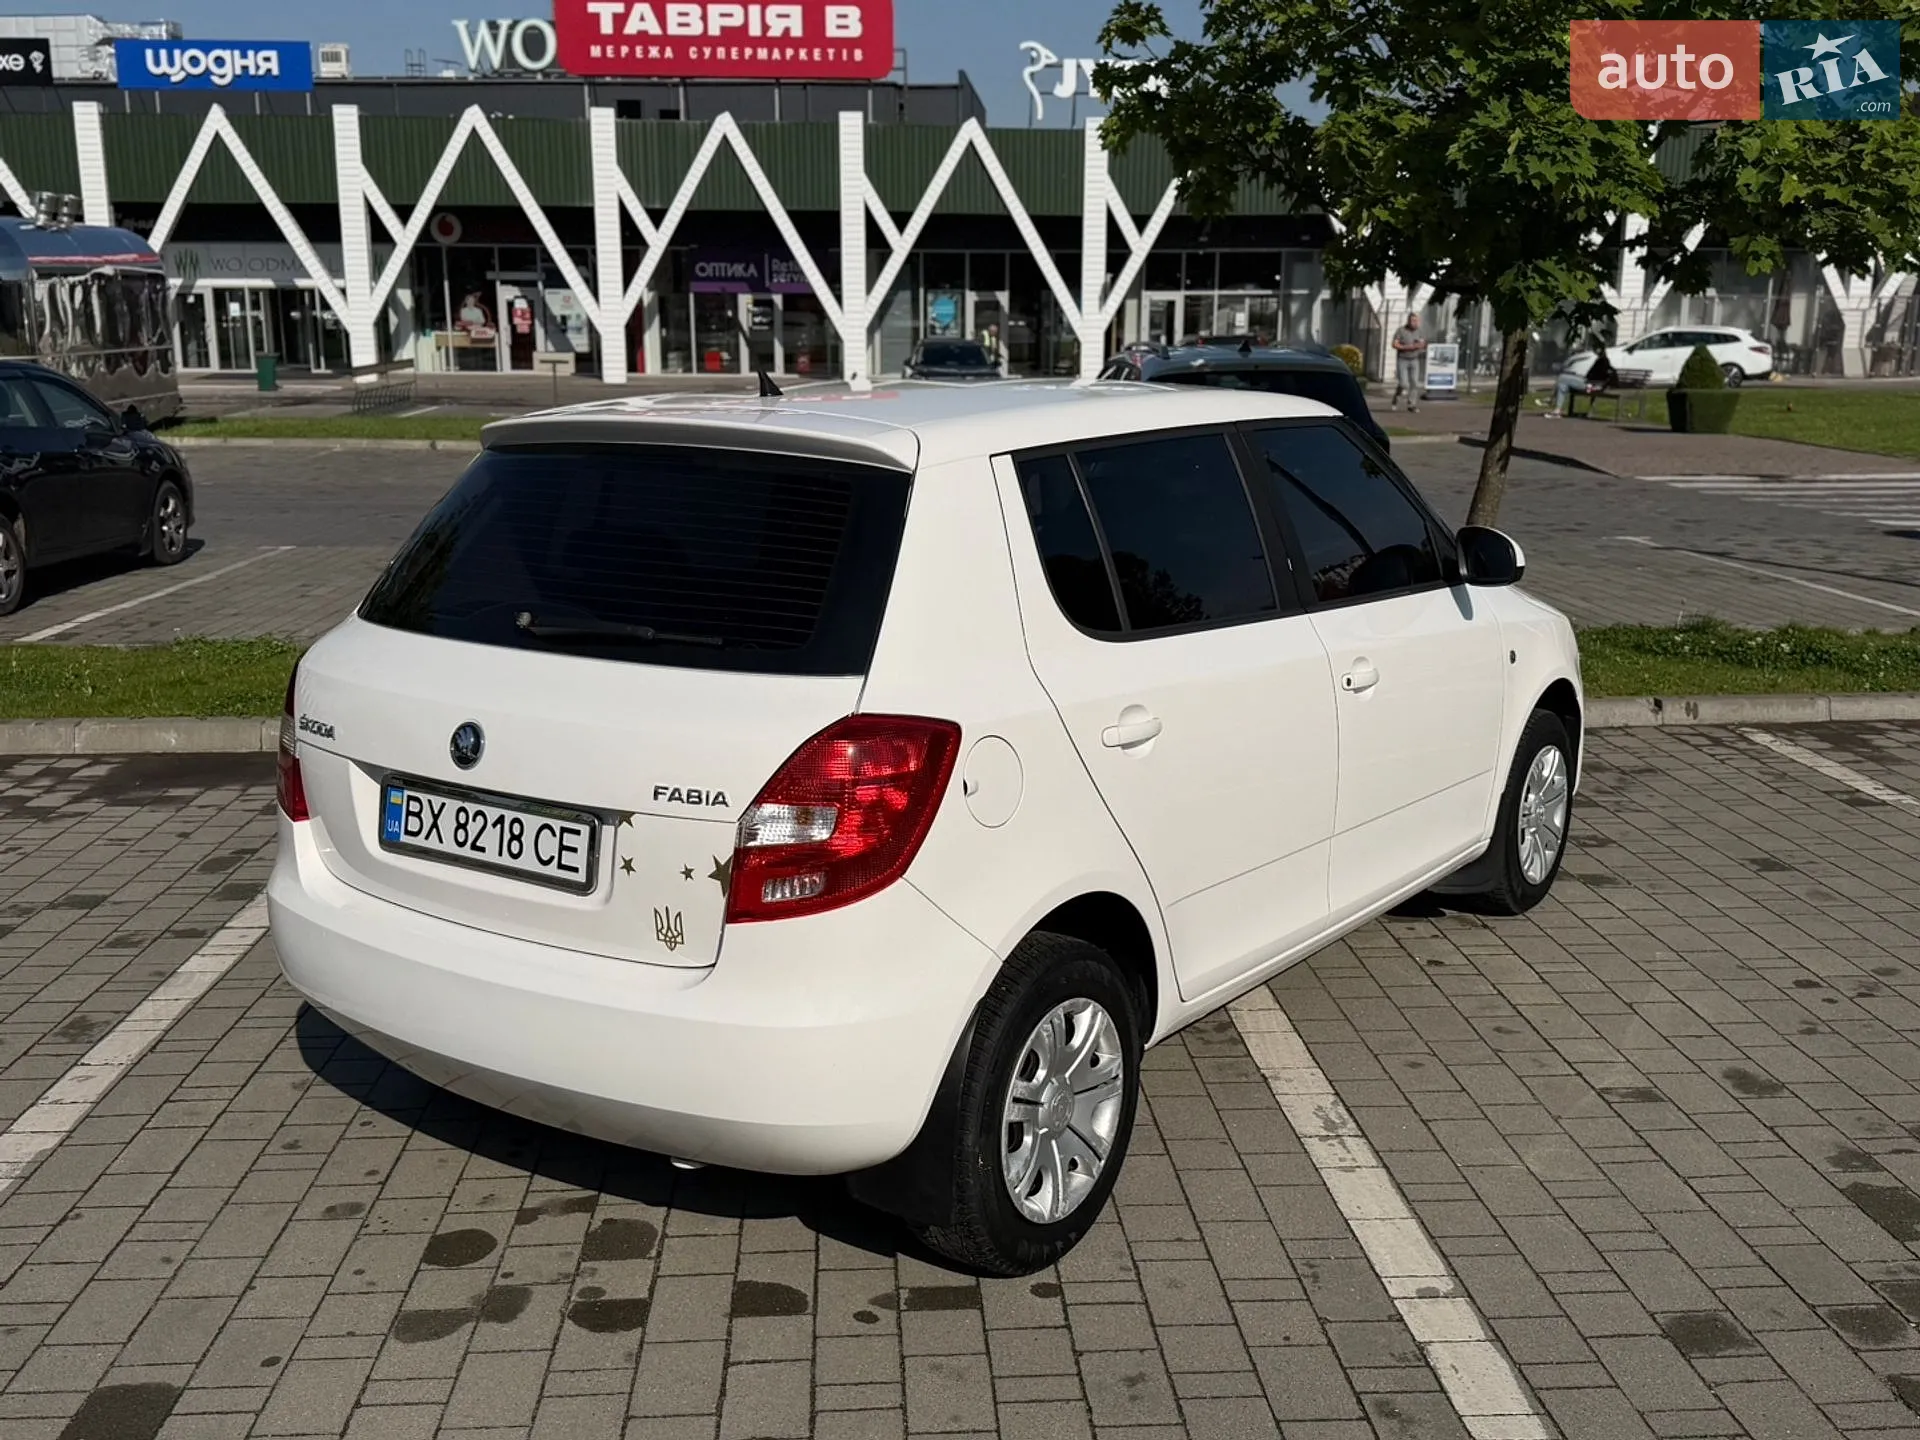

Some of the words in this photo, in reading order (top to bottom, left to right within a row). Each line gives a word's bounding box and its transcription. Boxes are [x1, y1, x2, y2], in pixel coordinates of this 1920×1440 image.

[587, 2, 804, 38] ТАВРІЯ
[825, 5, 864, 38] В
[452, 18, 557, 72] WO
[589, 45, 674, 60] МЕРЕЖА
[689, 46, 864, 62] СУПЕРМАРКЕТІВ
[694, 261, 758, 279] ОПТИКА
[653, 785, 730, 808] FABIA
[387, 820, 400, 834] UA
[403, 795, 446, 844] BX
[453, 806, 524, 860] 8218
[534, 822, 582, 874] CE
